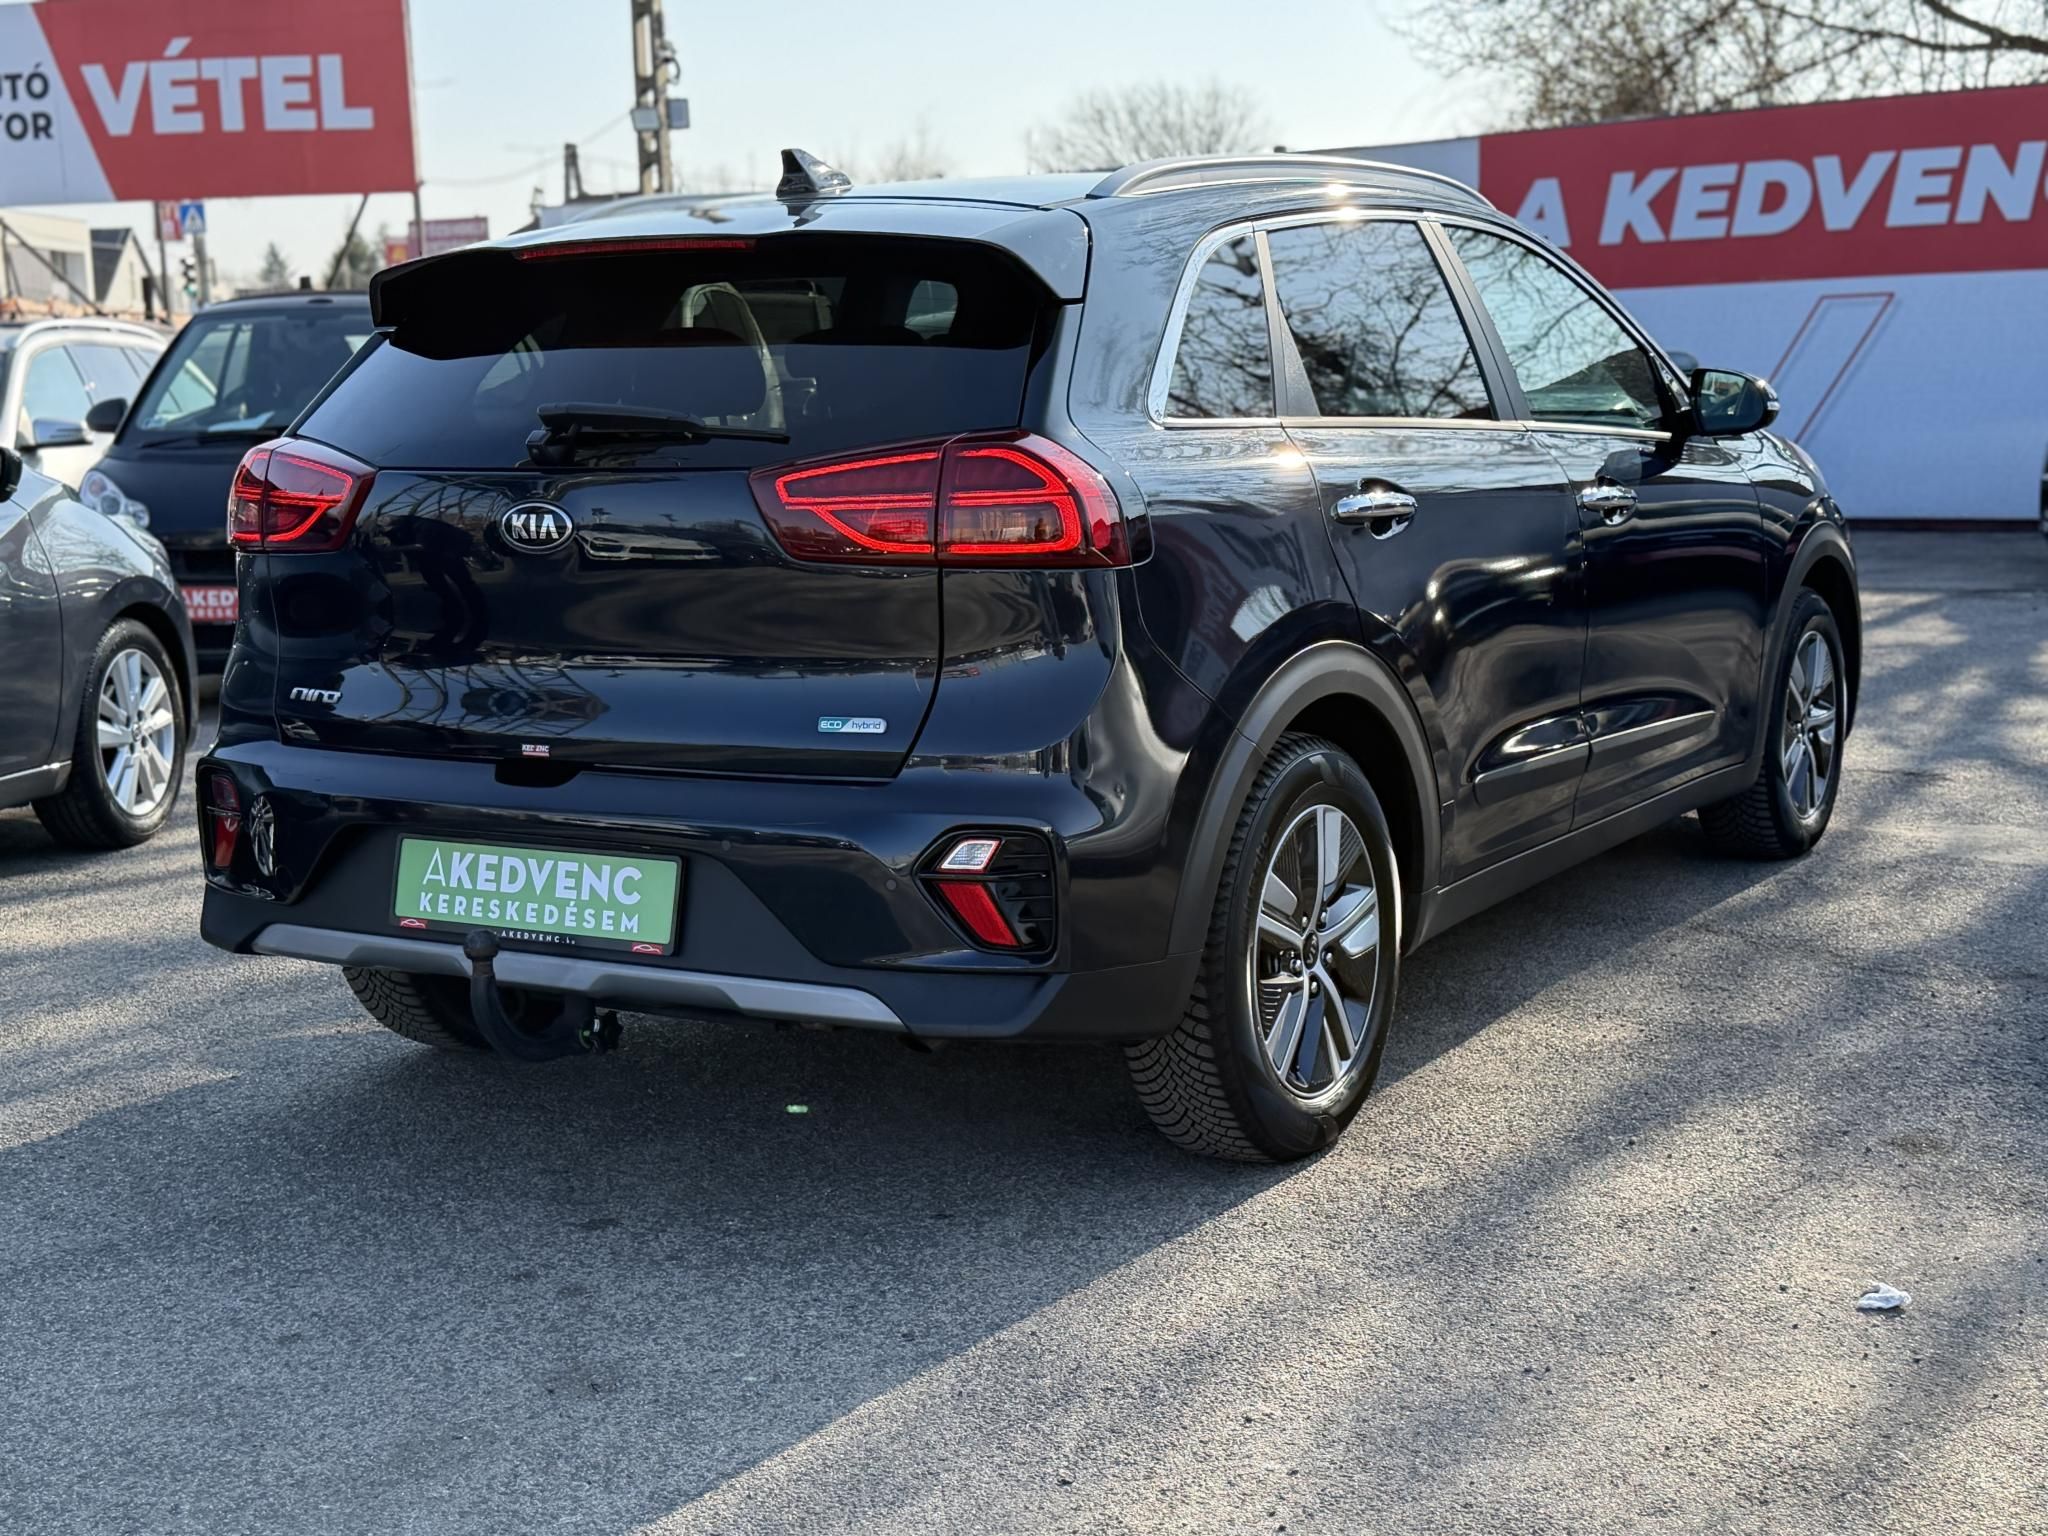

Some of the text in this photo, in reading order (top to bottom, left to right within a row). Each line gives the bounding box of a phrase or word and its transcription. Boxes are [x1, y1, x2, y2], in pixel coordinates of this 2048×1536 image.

[0, 62, 50, 101] TÓ
[80, 36, 375, 137] VÉTEL
[0, 111, 54, 141] OR
[1514, 140, 2048, 248] A KEDVEN
[511, 514, 559, 539] KIA
[851, 720, 881, 730] hybrid
[422, 847, 643, 906] AKEDVENC
[419, 891, 639, 934] KERESKEDÉSEM
